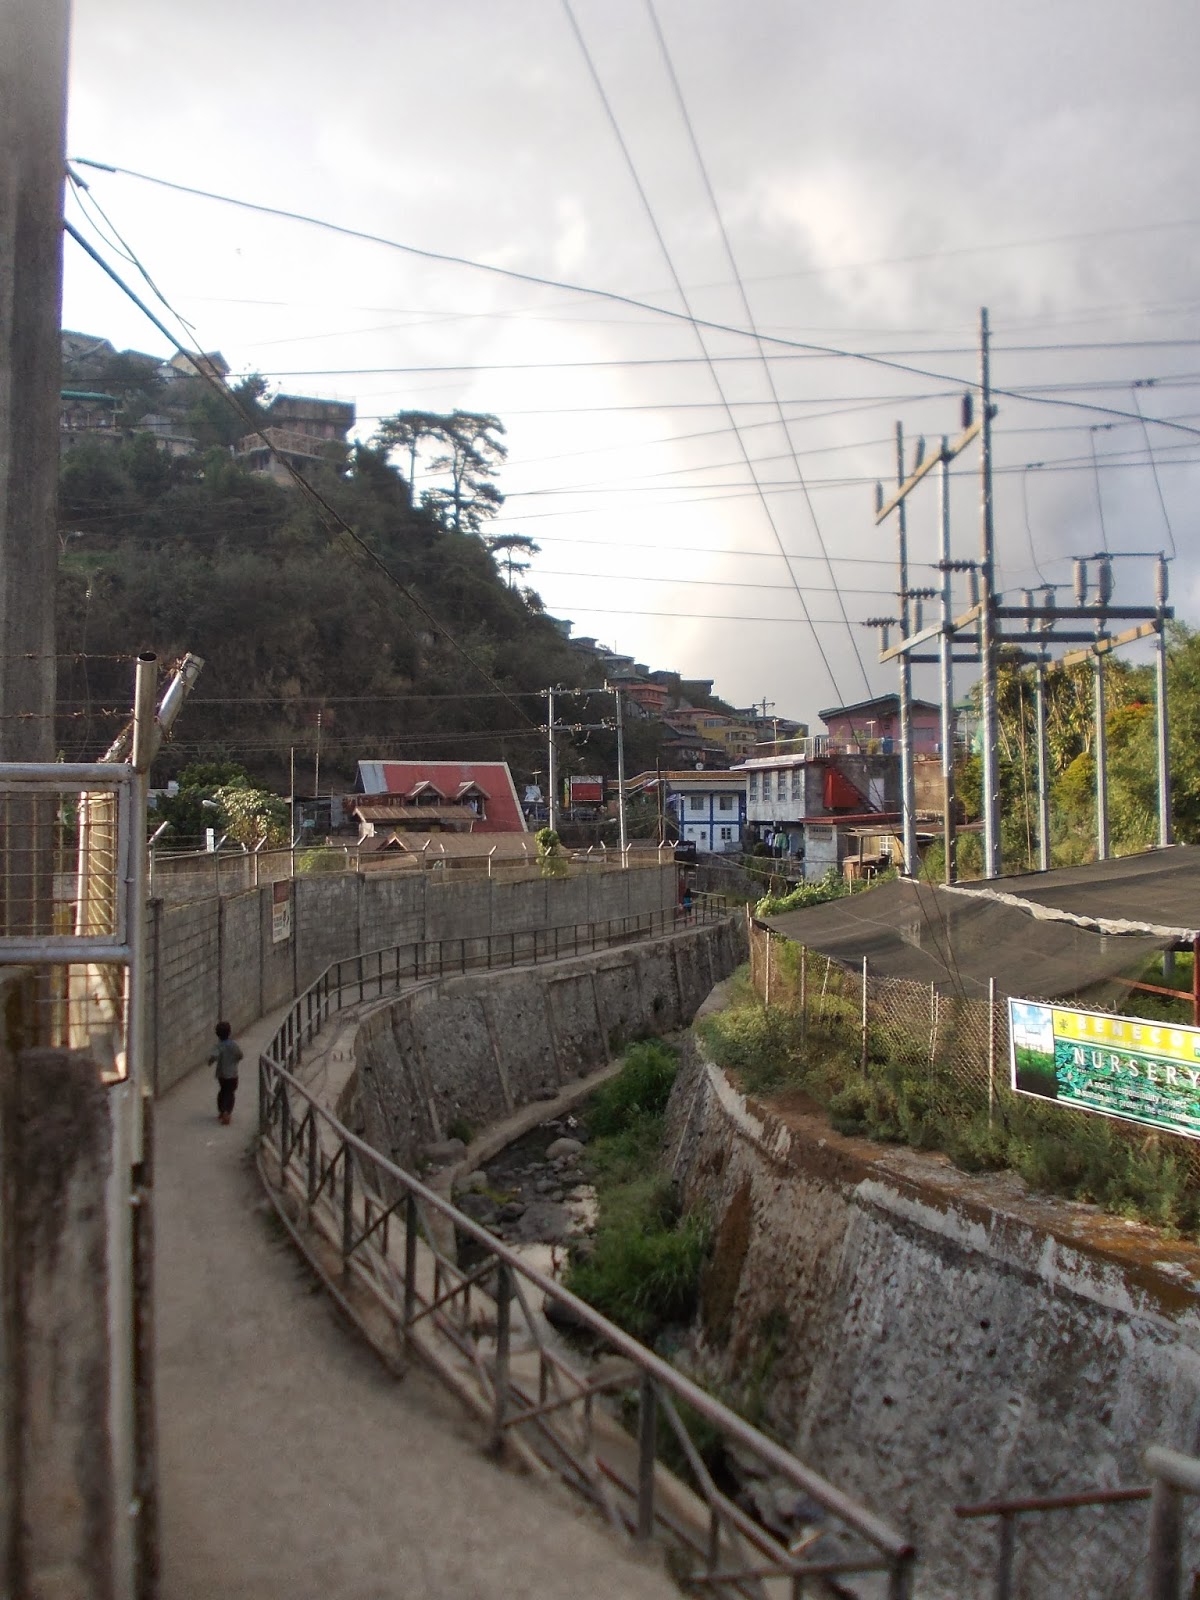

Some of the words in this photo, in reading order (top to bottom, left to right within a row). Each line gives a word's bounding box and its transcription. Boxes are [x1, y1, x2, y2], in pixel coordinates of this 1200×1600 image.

[1077, 1016, 1185, 1047] BENECO
[1073, 1047, 1200, 1089] NURSERY
[1094, 1080, 1113, 1091] social
[1116, 1087, 1160, 1104] responsibility
[1161, 1097, 1187, 1110] project
[1118, 1097, 1143, 1110] protect
[1144, 1103, 1156, 1114] the
